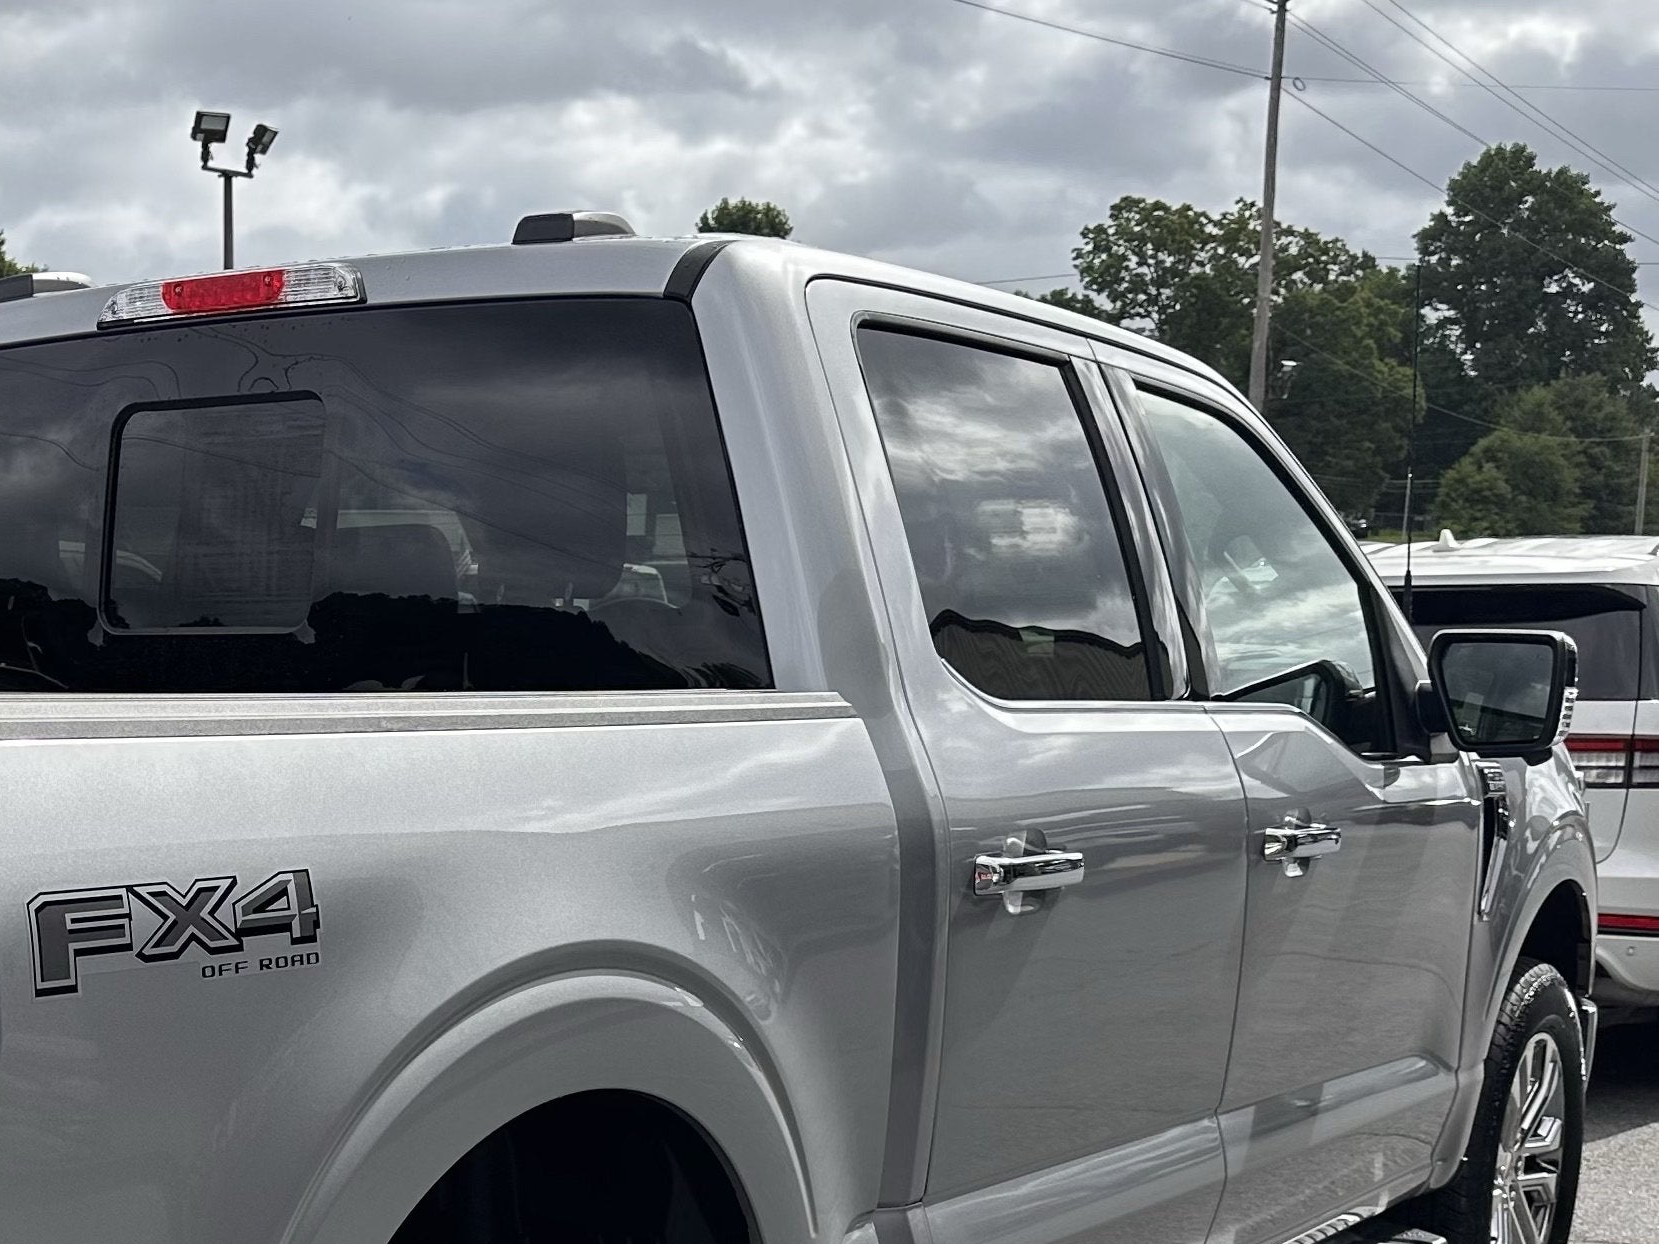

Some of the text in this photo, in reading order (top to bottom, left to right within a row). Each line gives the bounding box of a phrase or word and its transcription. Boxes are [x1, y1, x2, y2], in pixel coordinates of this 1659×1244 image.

[26, 869, 321, 998] FX4
[201, 952, 320, 979] OFF ROAD
